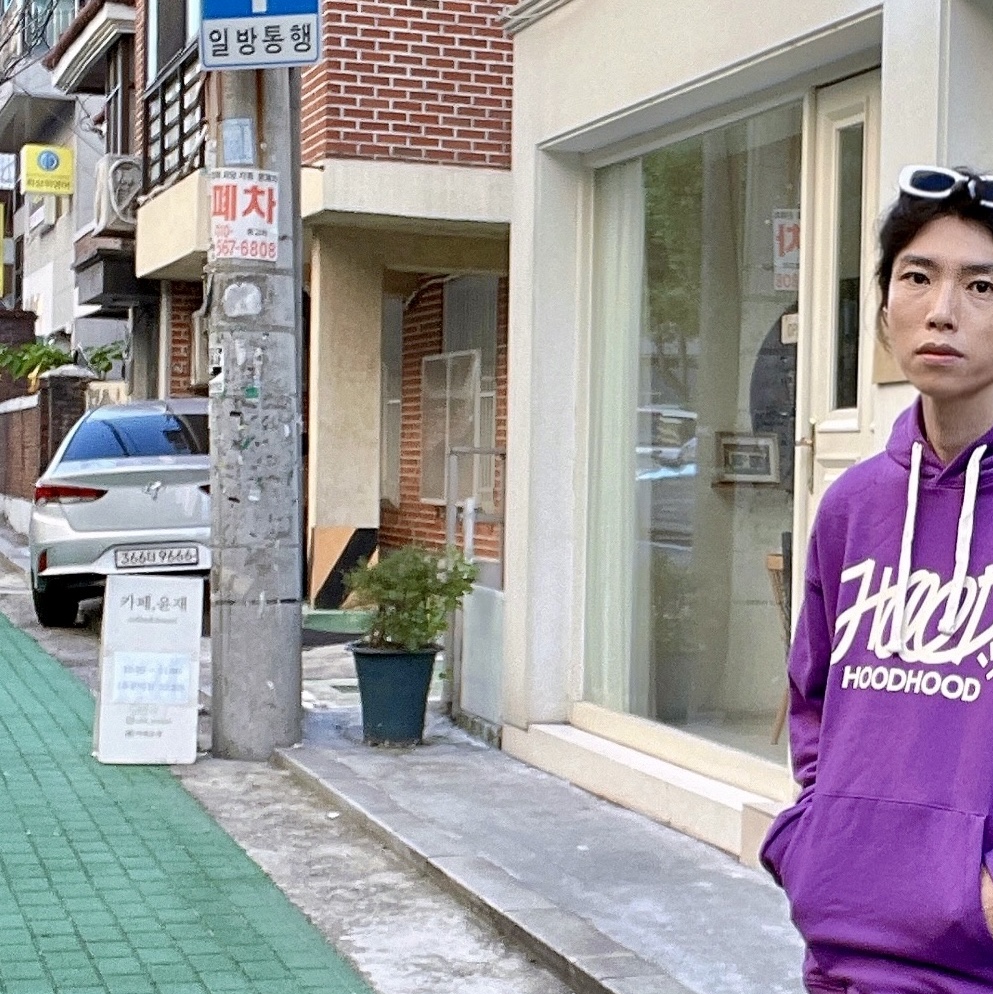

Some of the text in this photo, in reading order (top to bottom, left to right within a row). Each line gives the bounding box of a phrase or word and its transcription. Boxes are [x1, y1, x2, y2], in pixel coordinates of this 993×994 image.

[209, 23, 312, 57] 일방통행
[213, 185, 277, 224] 폐차
[841, 665, 981, 702] HOODHOOD
